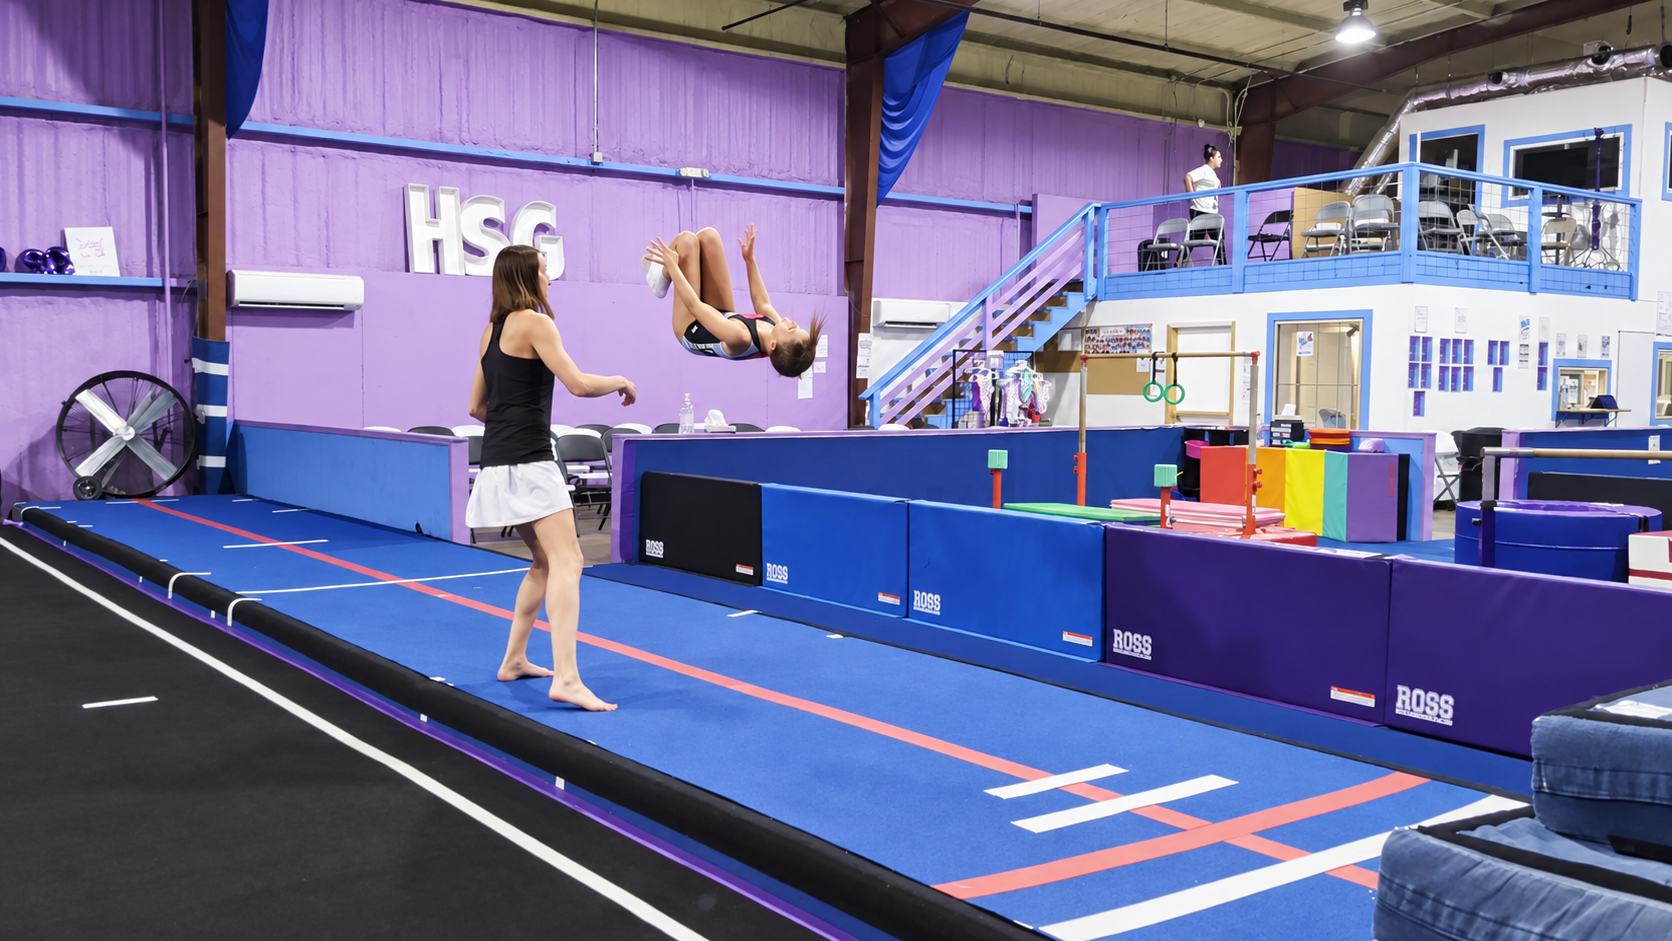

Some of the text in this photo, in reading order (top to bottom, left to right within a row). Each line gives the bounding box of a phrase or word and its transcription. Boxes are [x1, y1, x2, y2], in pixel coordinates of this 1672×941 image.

[404, 183, 565, 281] HSG
[645, 539, 664, 555] ROSS
[766, 562, 788, 581] ROSS
[913, 590, 941, 611] ROSS
[1113, 628, 1152, 656] ROSS
[1396, 684, 1455, 719] ROSS
